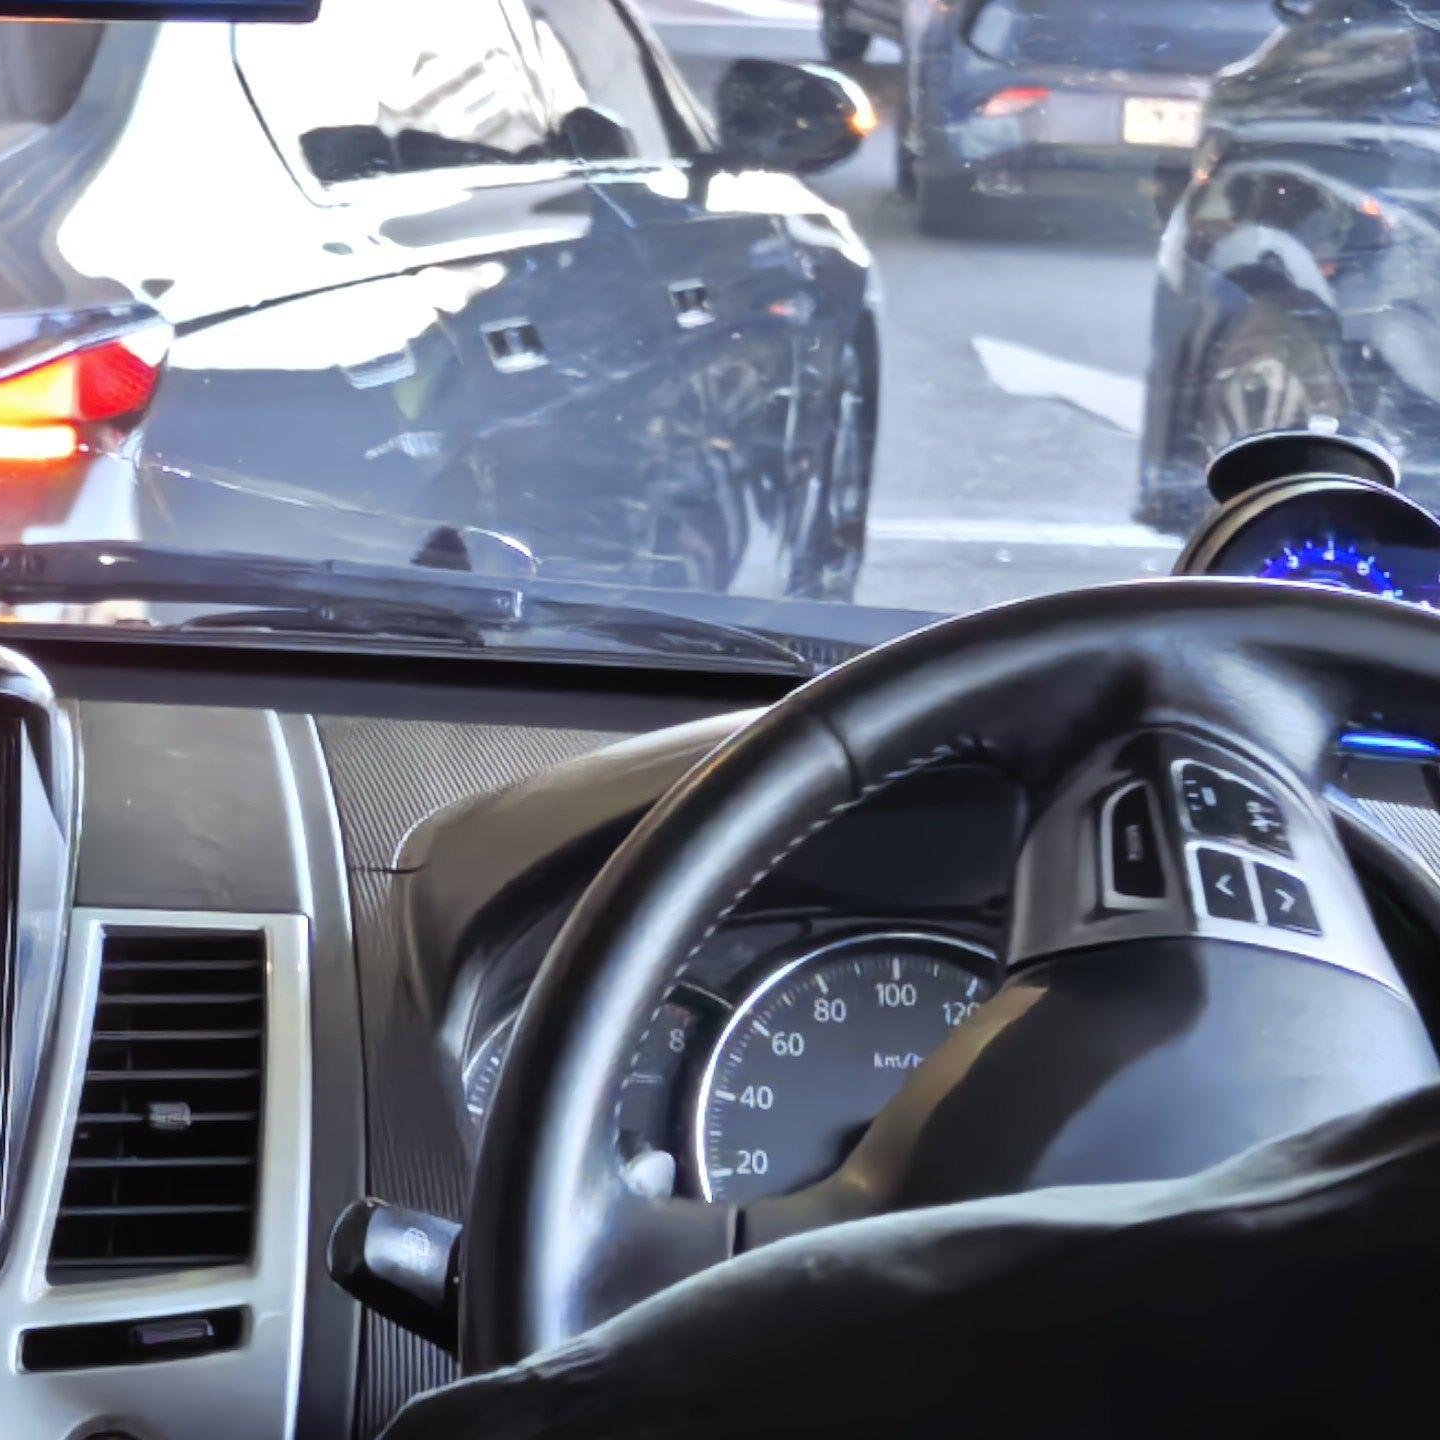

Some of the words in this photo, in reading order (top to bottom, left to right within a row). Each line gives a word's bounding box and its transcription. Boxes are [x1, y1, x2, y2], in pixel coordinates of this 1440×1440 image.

[874, 982, 918, 1008] 100
[813, 998, 847, 1024] 80
[771, 1031, 805, 1057] 60
[739, 1085, 773, 1111] 40
[736, 1149, 769, 1176] 20
